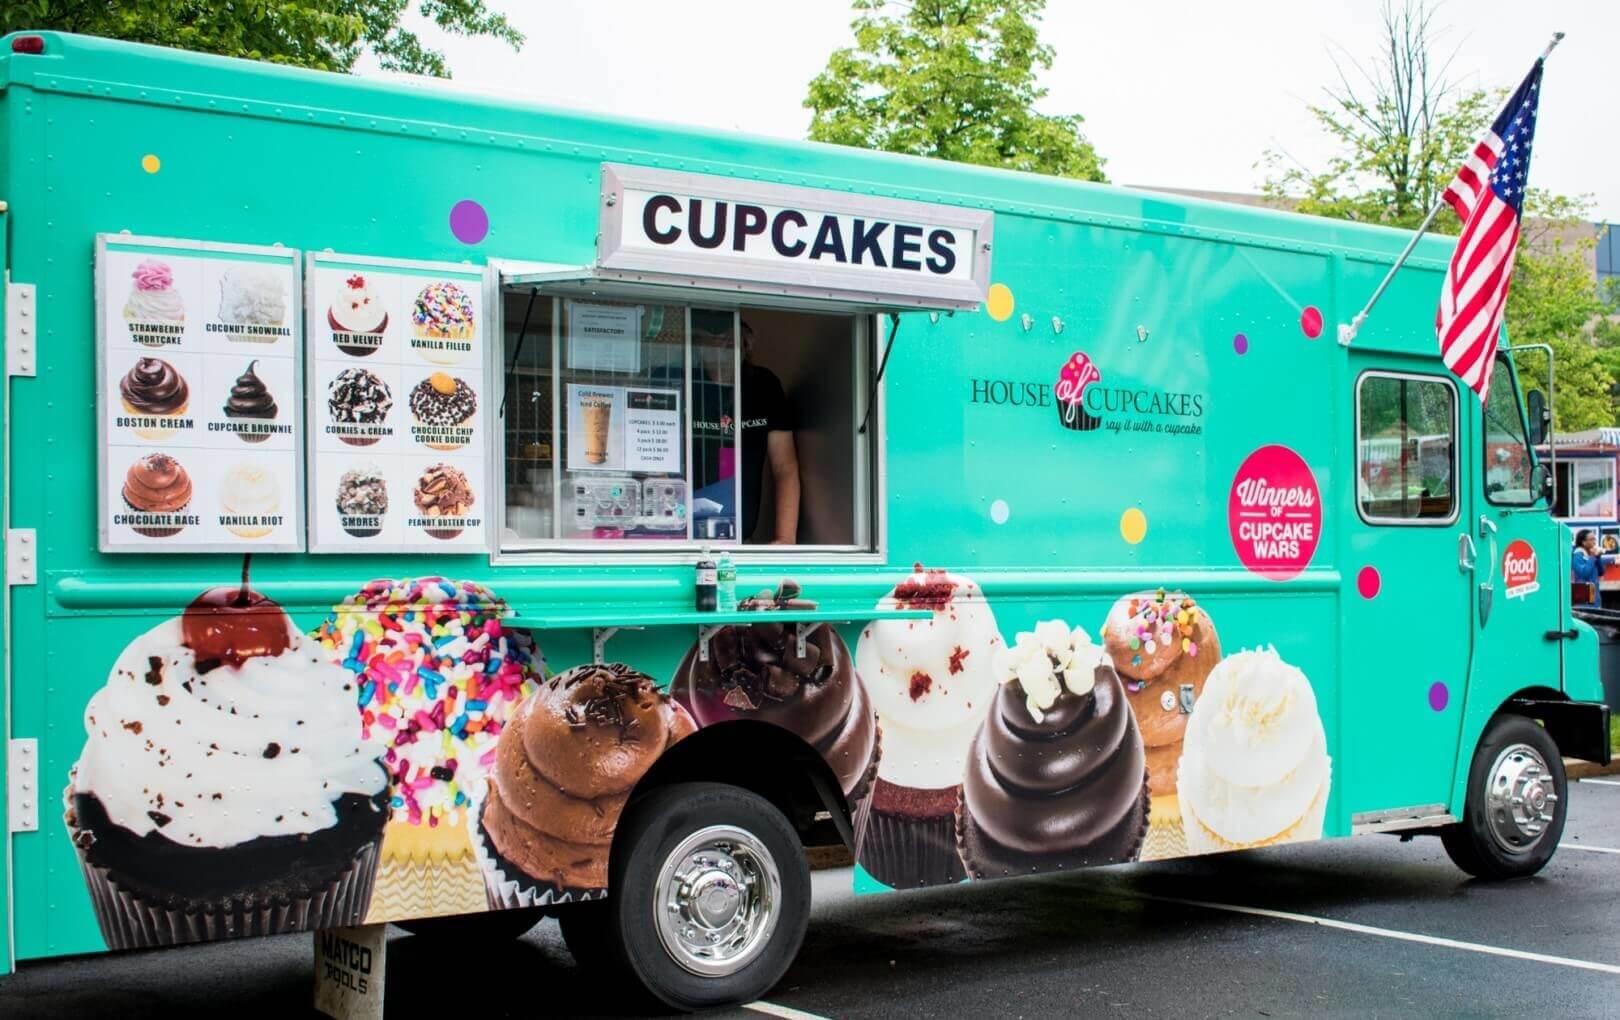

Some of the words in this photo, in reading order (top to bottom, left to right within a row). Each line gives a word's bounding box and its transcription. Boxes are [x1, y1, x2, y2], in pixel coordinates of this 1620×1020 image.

[643, 194, 957, 274] CUPCAKES
[128, 323, 185, 334] STRAWBERRY
[205, 323, 245, 334] COCONUT
[247, 326, 291, 336] SNOWBALL
[583, 327, 625, 335] SATISFACTORY
[132, 334, 182, 345] SHORTCAKE
[332, 333, 350, 343] RED
[352, 334, 383, 345] VELVET
[411, 339, 443, 350] VANILLA
[446, 341, 471, 351] FILLED
[578, 390, 592, 398] Cold
[971, 379, 1051, 407] HOUSE
[1056, 362, 1093, 423] of
[1086, 387, 1204, 417] CUPCAKES
[117, 417, 157, 428] BOSTON
[160, 418, 194, 429] CREAM
[208, 422, 249, 432] CUPCAKE
[251, 424, 292, 434] BROWNIE
[693, 420, 720, 430] HOUSE
[729, 418, 768, 430] CPCAKES
[1105, 420, 1121, 435] say
[1123, 419, 1132, 431] it
[1133, 420, 1154, 432] with
[1155, 423, 1162, 433] a
[1164, 423, 1201, 436] cupcake
[325, 425, 359, 435] COOKIES
[368, 426, 393, 436] CREAM
[411, 426, 454, 435] CHOCOLATE
[456, 427, 474, 436] CHIP
[415, 435, 442, 444] COOKIE
[444, 435, 471, 444] DOUGH
[1236, 477, 1315, 507] Winners
[1270, 506, 1283, 517] OF
[114, 514, 172, 525] CHOCOLATE
[175, 515, 200, 525] RAGE
[219, 516, 258, 526] VANILLA
[261, 516, 283, 526] RIOT
[342, 517, 379, 527] SMORES
[408, 518, 435, 527] PEANUT
[437, 518, 465, 527] BUTTER
[467, 518, 481, 527] CUP
[1239, 522, 1313, 541] CUPCAKE
[1253, 541, 1300, 559] WARS
[1504, 551, 1537, 583] food
[321, 930, 372, 975] MATCO
[325, 961, 368, 995] TOOLS
